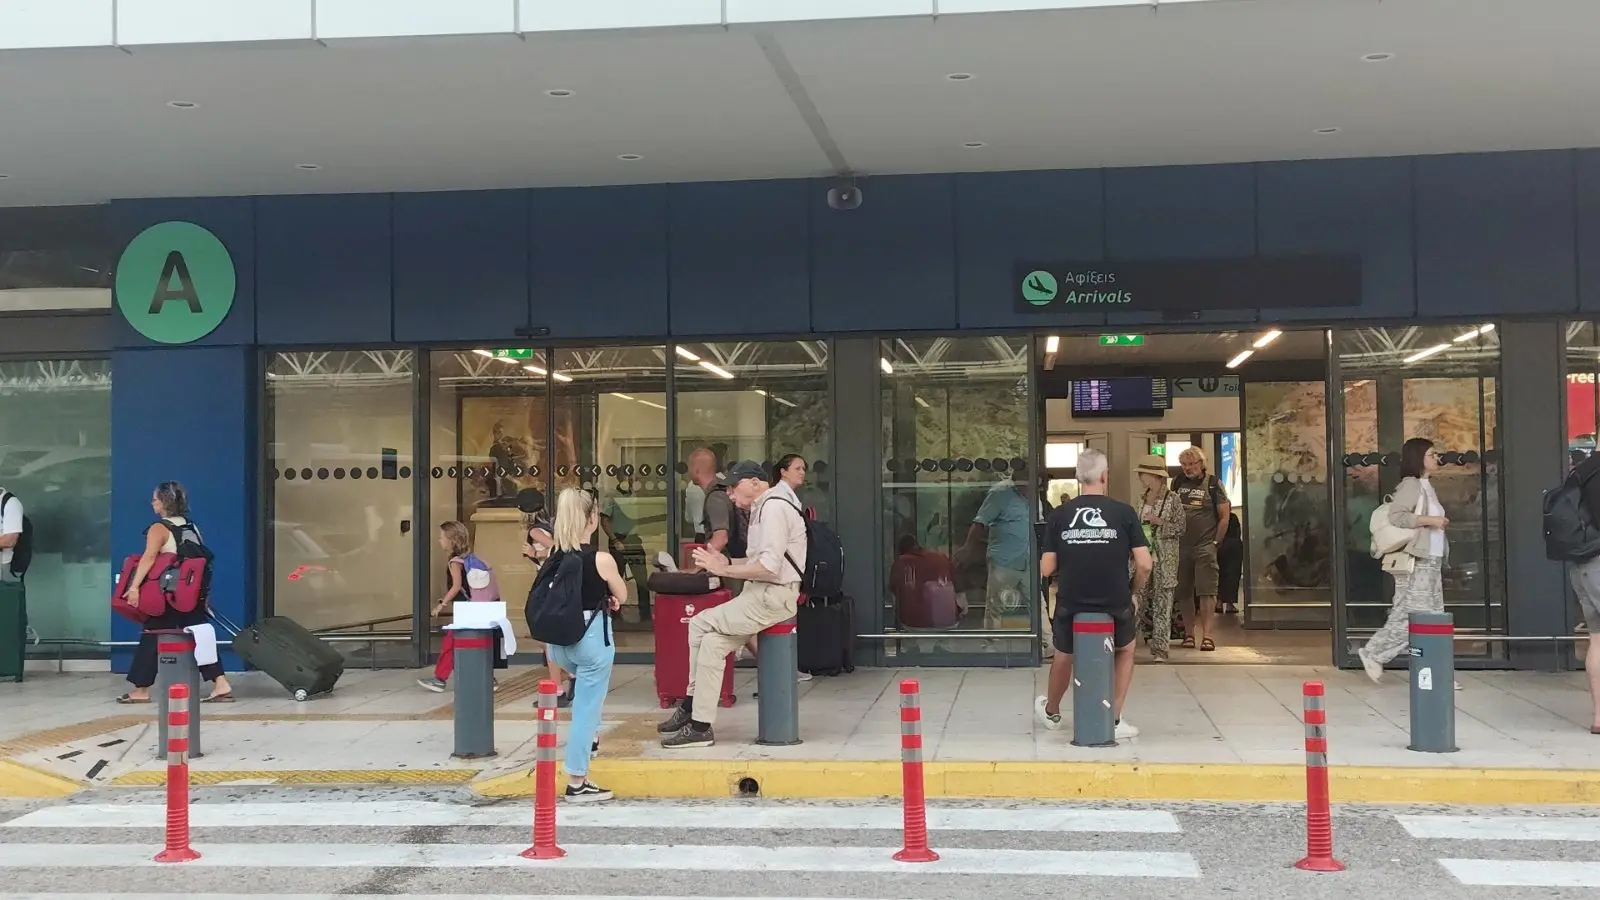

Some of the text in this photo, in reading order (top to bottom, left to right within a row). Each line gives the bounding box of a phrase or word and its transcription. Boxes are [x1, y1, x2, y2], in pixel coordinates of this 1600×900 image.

[148, 250, 203, 314] A
[1065, 270, 1116, 286] Αφίξεις
[1065, 289, 1132, 304] Arrivals
[1566, 372, 1595, 384] ree
[1223, 383, 1240, 392] Toil
